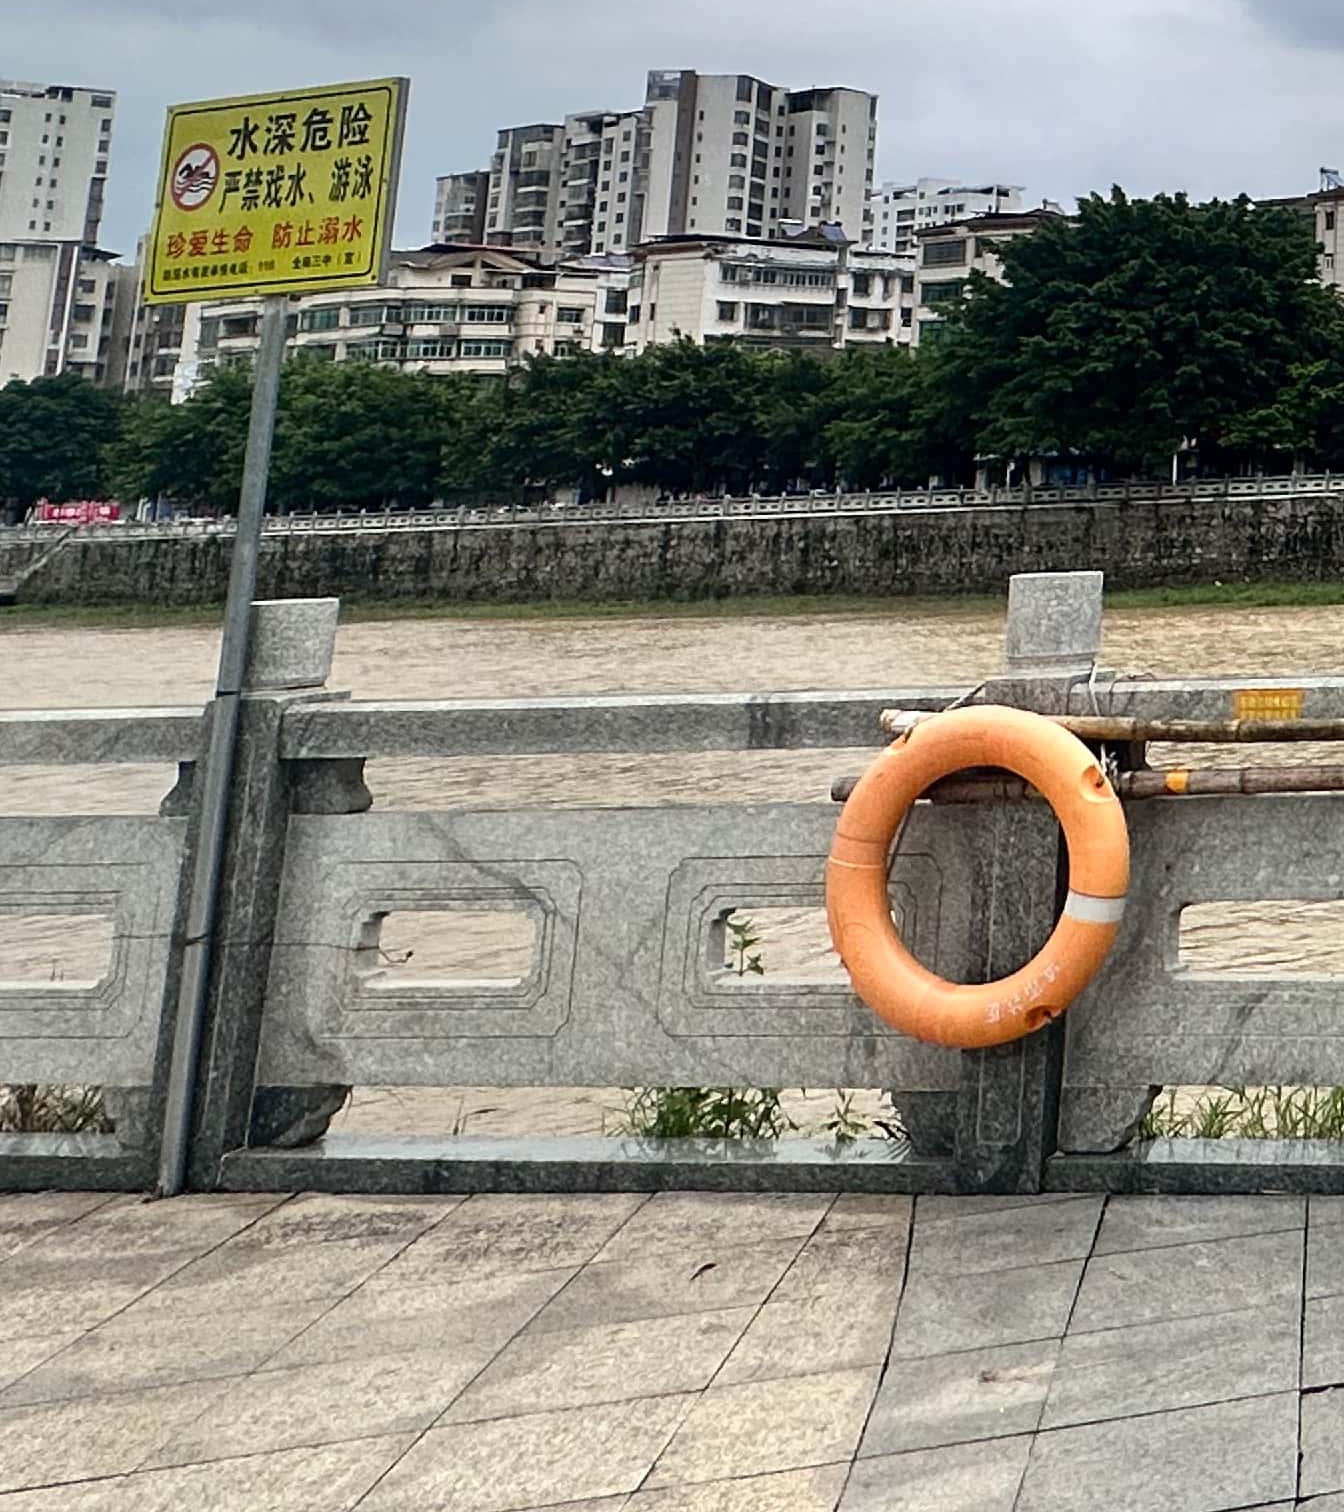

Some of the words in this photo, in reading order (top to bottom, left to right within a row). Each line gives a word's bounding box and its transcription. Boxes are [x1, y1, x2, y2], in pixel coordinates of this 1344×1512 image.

[227, 102, 373, 161] 水深危险
[166, 225, 254, 260] 珍爱生命
[271, 214, 364, 250] 防止溺水
